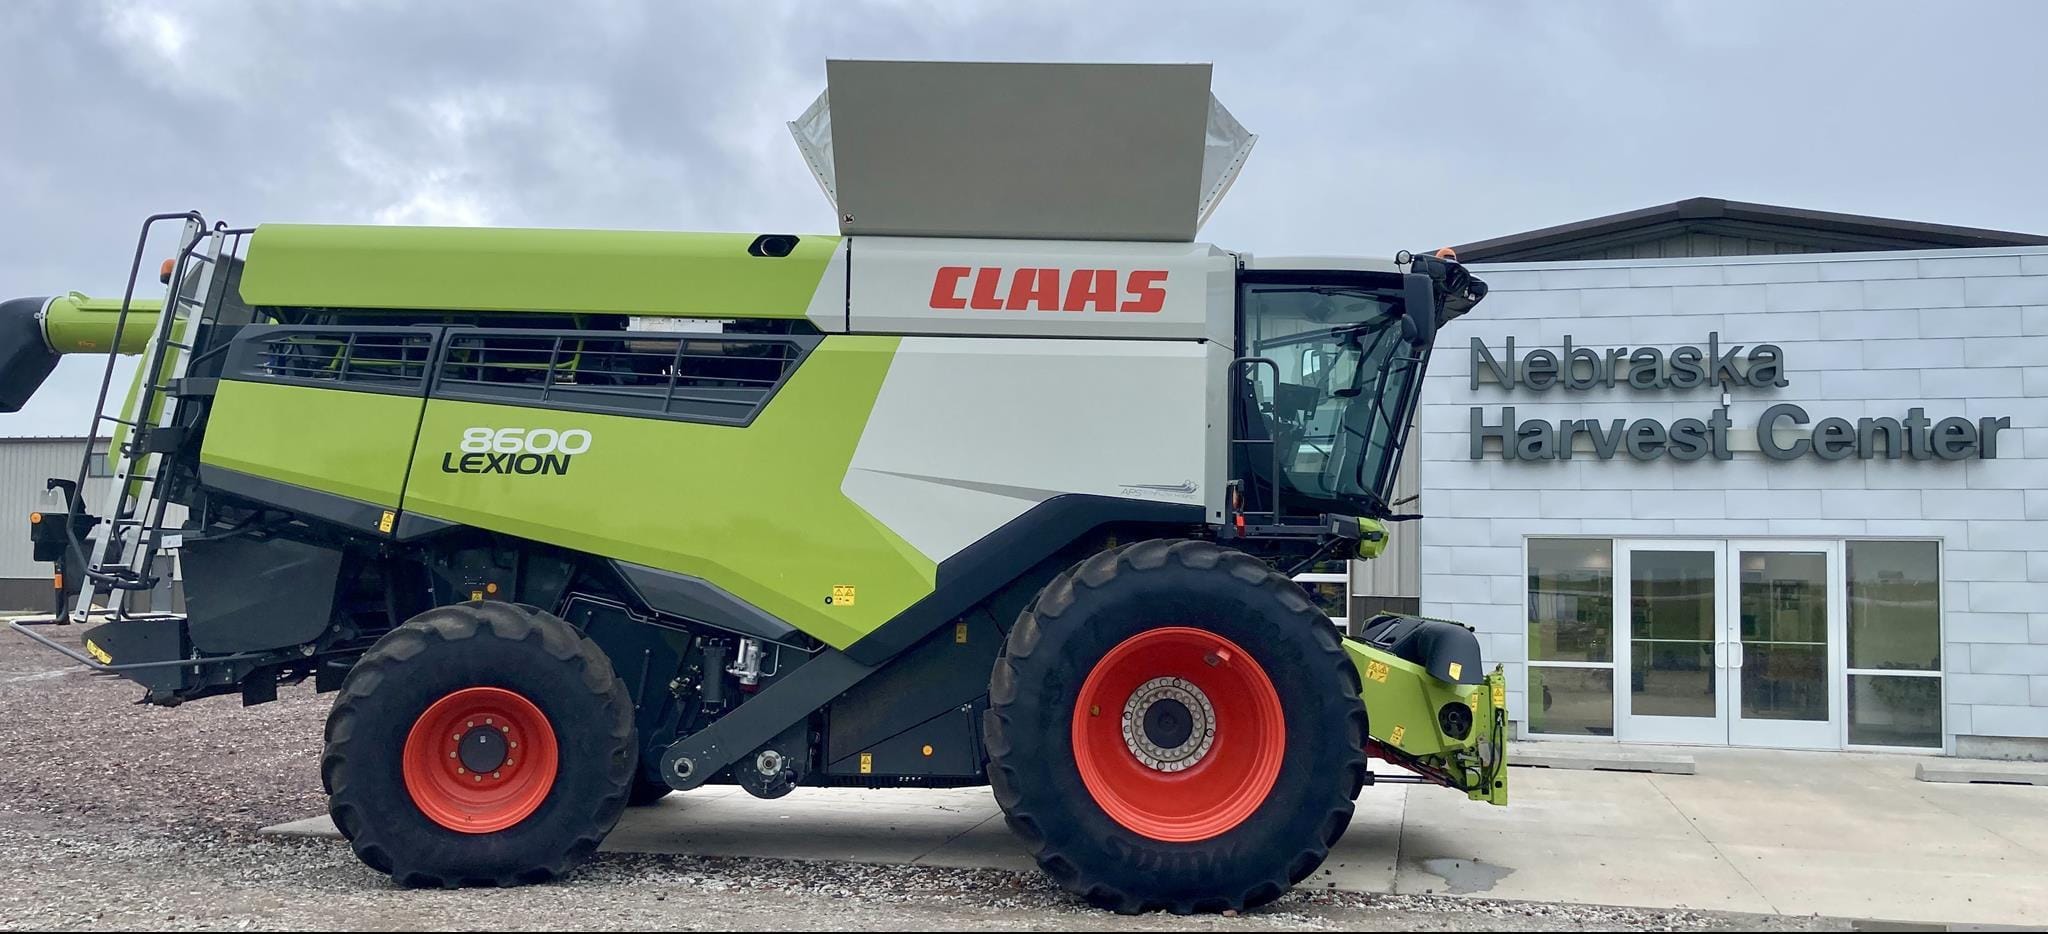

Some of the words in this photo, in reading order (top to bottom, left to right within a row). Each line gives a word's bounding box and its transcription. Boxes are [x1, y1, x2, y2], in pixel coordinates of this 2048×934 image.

[929, 266, 1169, 313] CLAAS
[1470, 331, 1790, 391] Nebraska
[460, 427, 592, 454] 8600
[1470, 406, 1733, 460] Harvest
[1756, 403, 2011, 461] Center
[442, 452, 571, 475] LEXION
